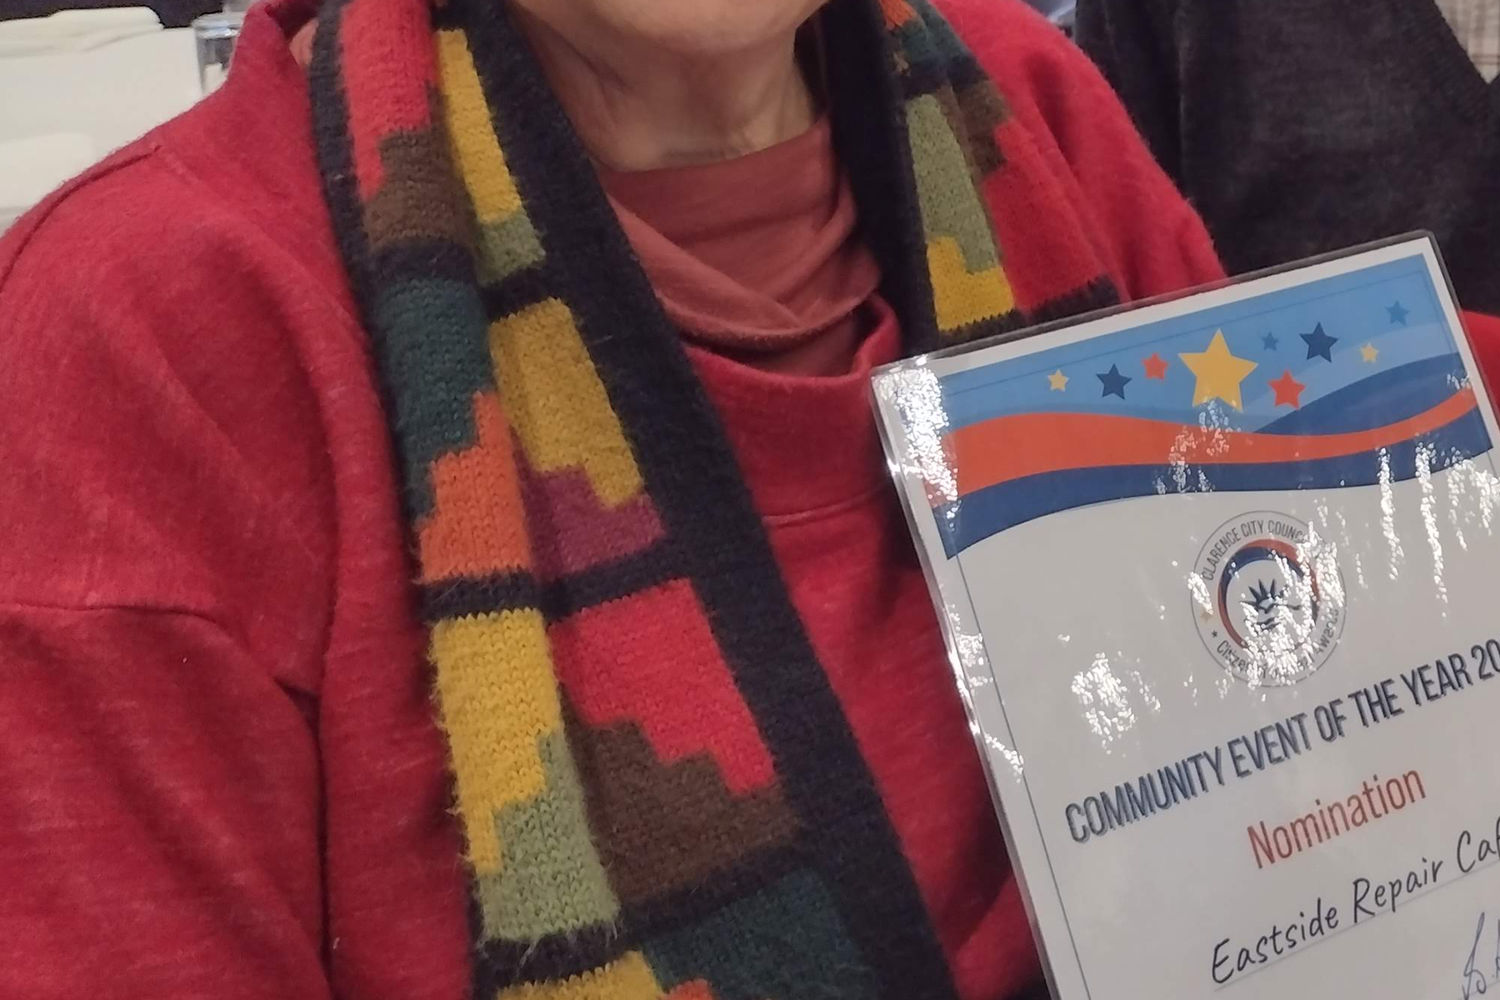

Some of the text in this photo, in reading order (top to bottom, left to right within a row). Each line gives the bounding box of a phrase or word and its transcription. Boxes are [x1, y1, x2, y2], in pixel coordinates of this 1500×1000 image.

[1201, 527, 1241, 581] CLARENCE
[1240, 520, 1264, 537] CITY
[1064, 746, 1226, 843] COMMUNITY
[1227, 713, 1312, 779] EVENT
[1313, 698, 1347, 743] OF
[1347, 676, 1404, 731] THE
[1400, 653, 1472, 708] YEAR
[1246, 769, 1426, 869] Nomination
[1210, 897, 1340, 985] Eastside
[1352, 856, 1445, 924] Repair
